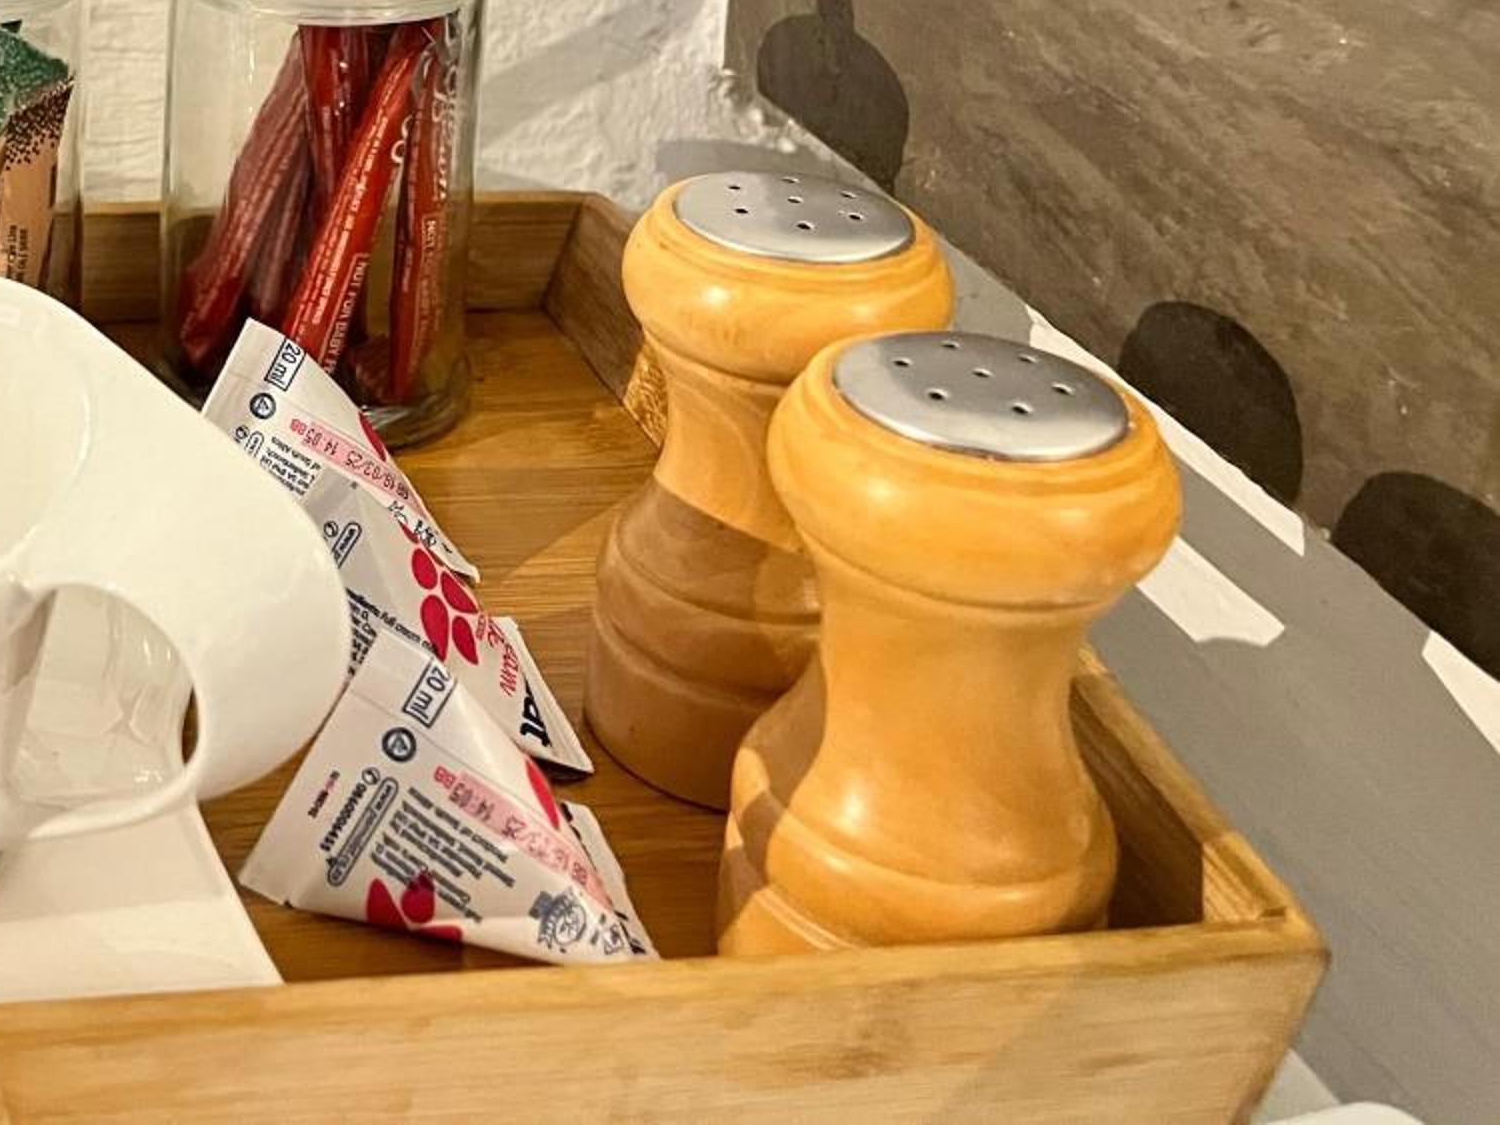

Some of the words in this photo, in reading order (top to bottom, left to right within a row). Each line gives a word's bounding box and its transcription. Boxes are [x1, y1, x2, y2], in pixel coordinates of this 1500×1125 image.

[282, 342, 301, 365] 20
[270, 364, 288, 386] ml
[427, 665, 451, 693] 20
[410, 691, 434, 720] ml
